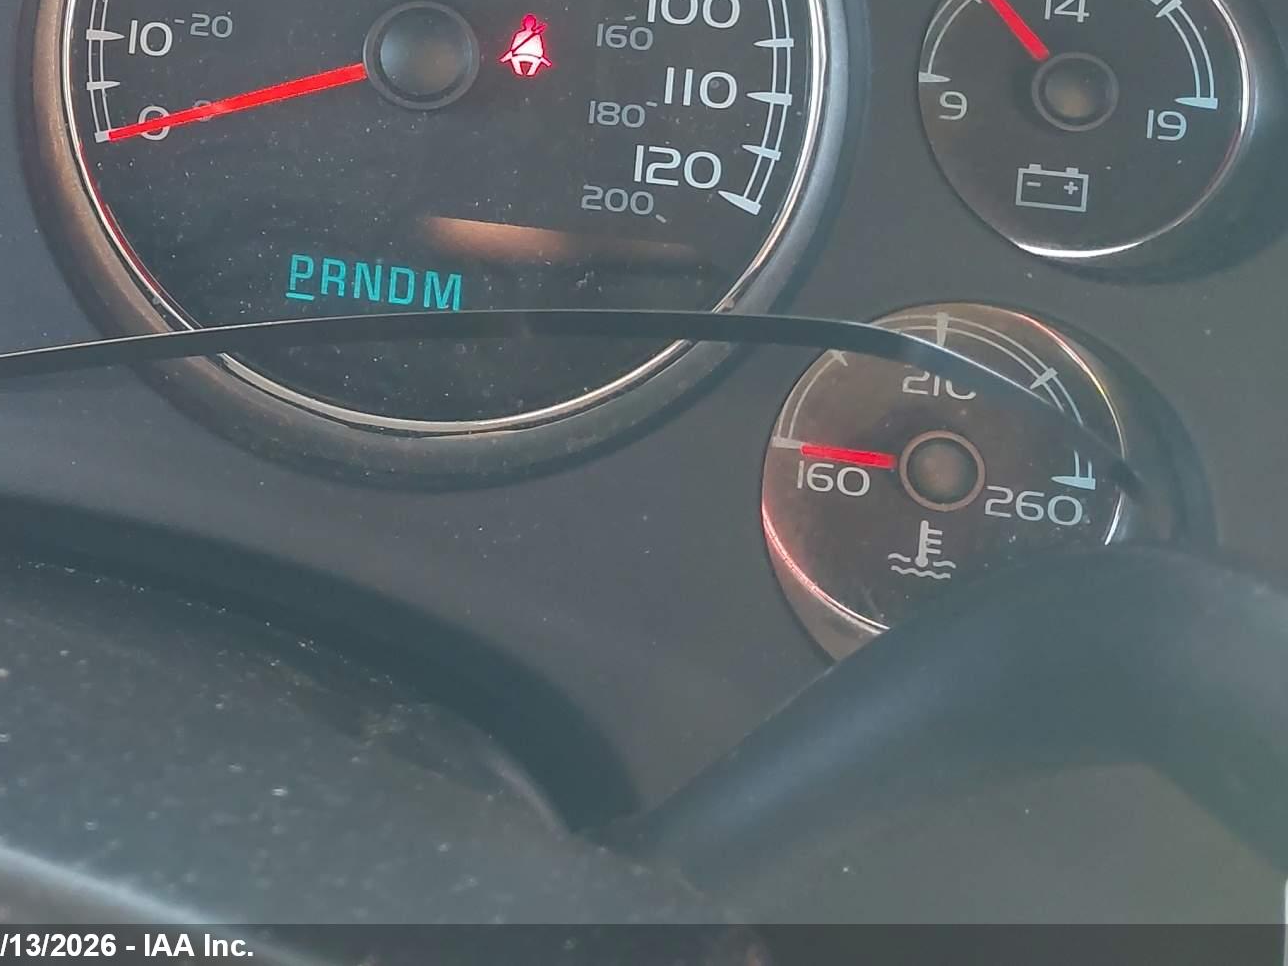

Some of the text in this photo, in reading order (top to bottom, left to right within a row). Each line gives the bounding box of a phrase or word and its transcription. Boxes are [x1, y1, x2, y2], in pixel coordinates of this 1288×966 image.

[128, 19, 172, 56] 10
[189, 13, 233, 38] 20
[596, 23, 654, 51] 160
[664, 66, 738, 109] 110
[938, 90, 968, 121] 9
[137, 105, 171, 141] 0
[587, 100, 646, 128] 180
[1146, 109, 1188, 141] 19
[633, 144, 722, 189] 120
[580, 184, 654, 215] 200
[288, 253, 462, 312] PRNDM
[796, 460, 871, 496] 160
[984, 485, 1083, 526] 260
